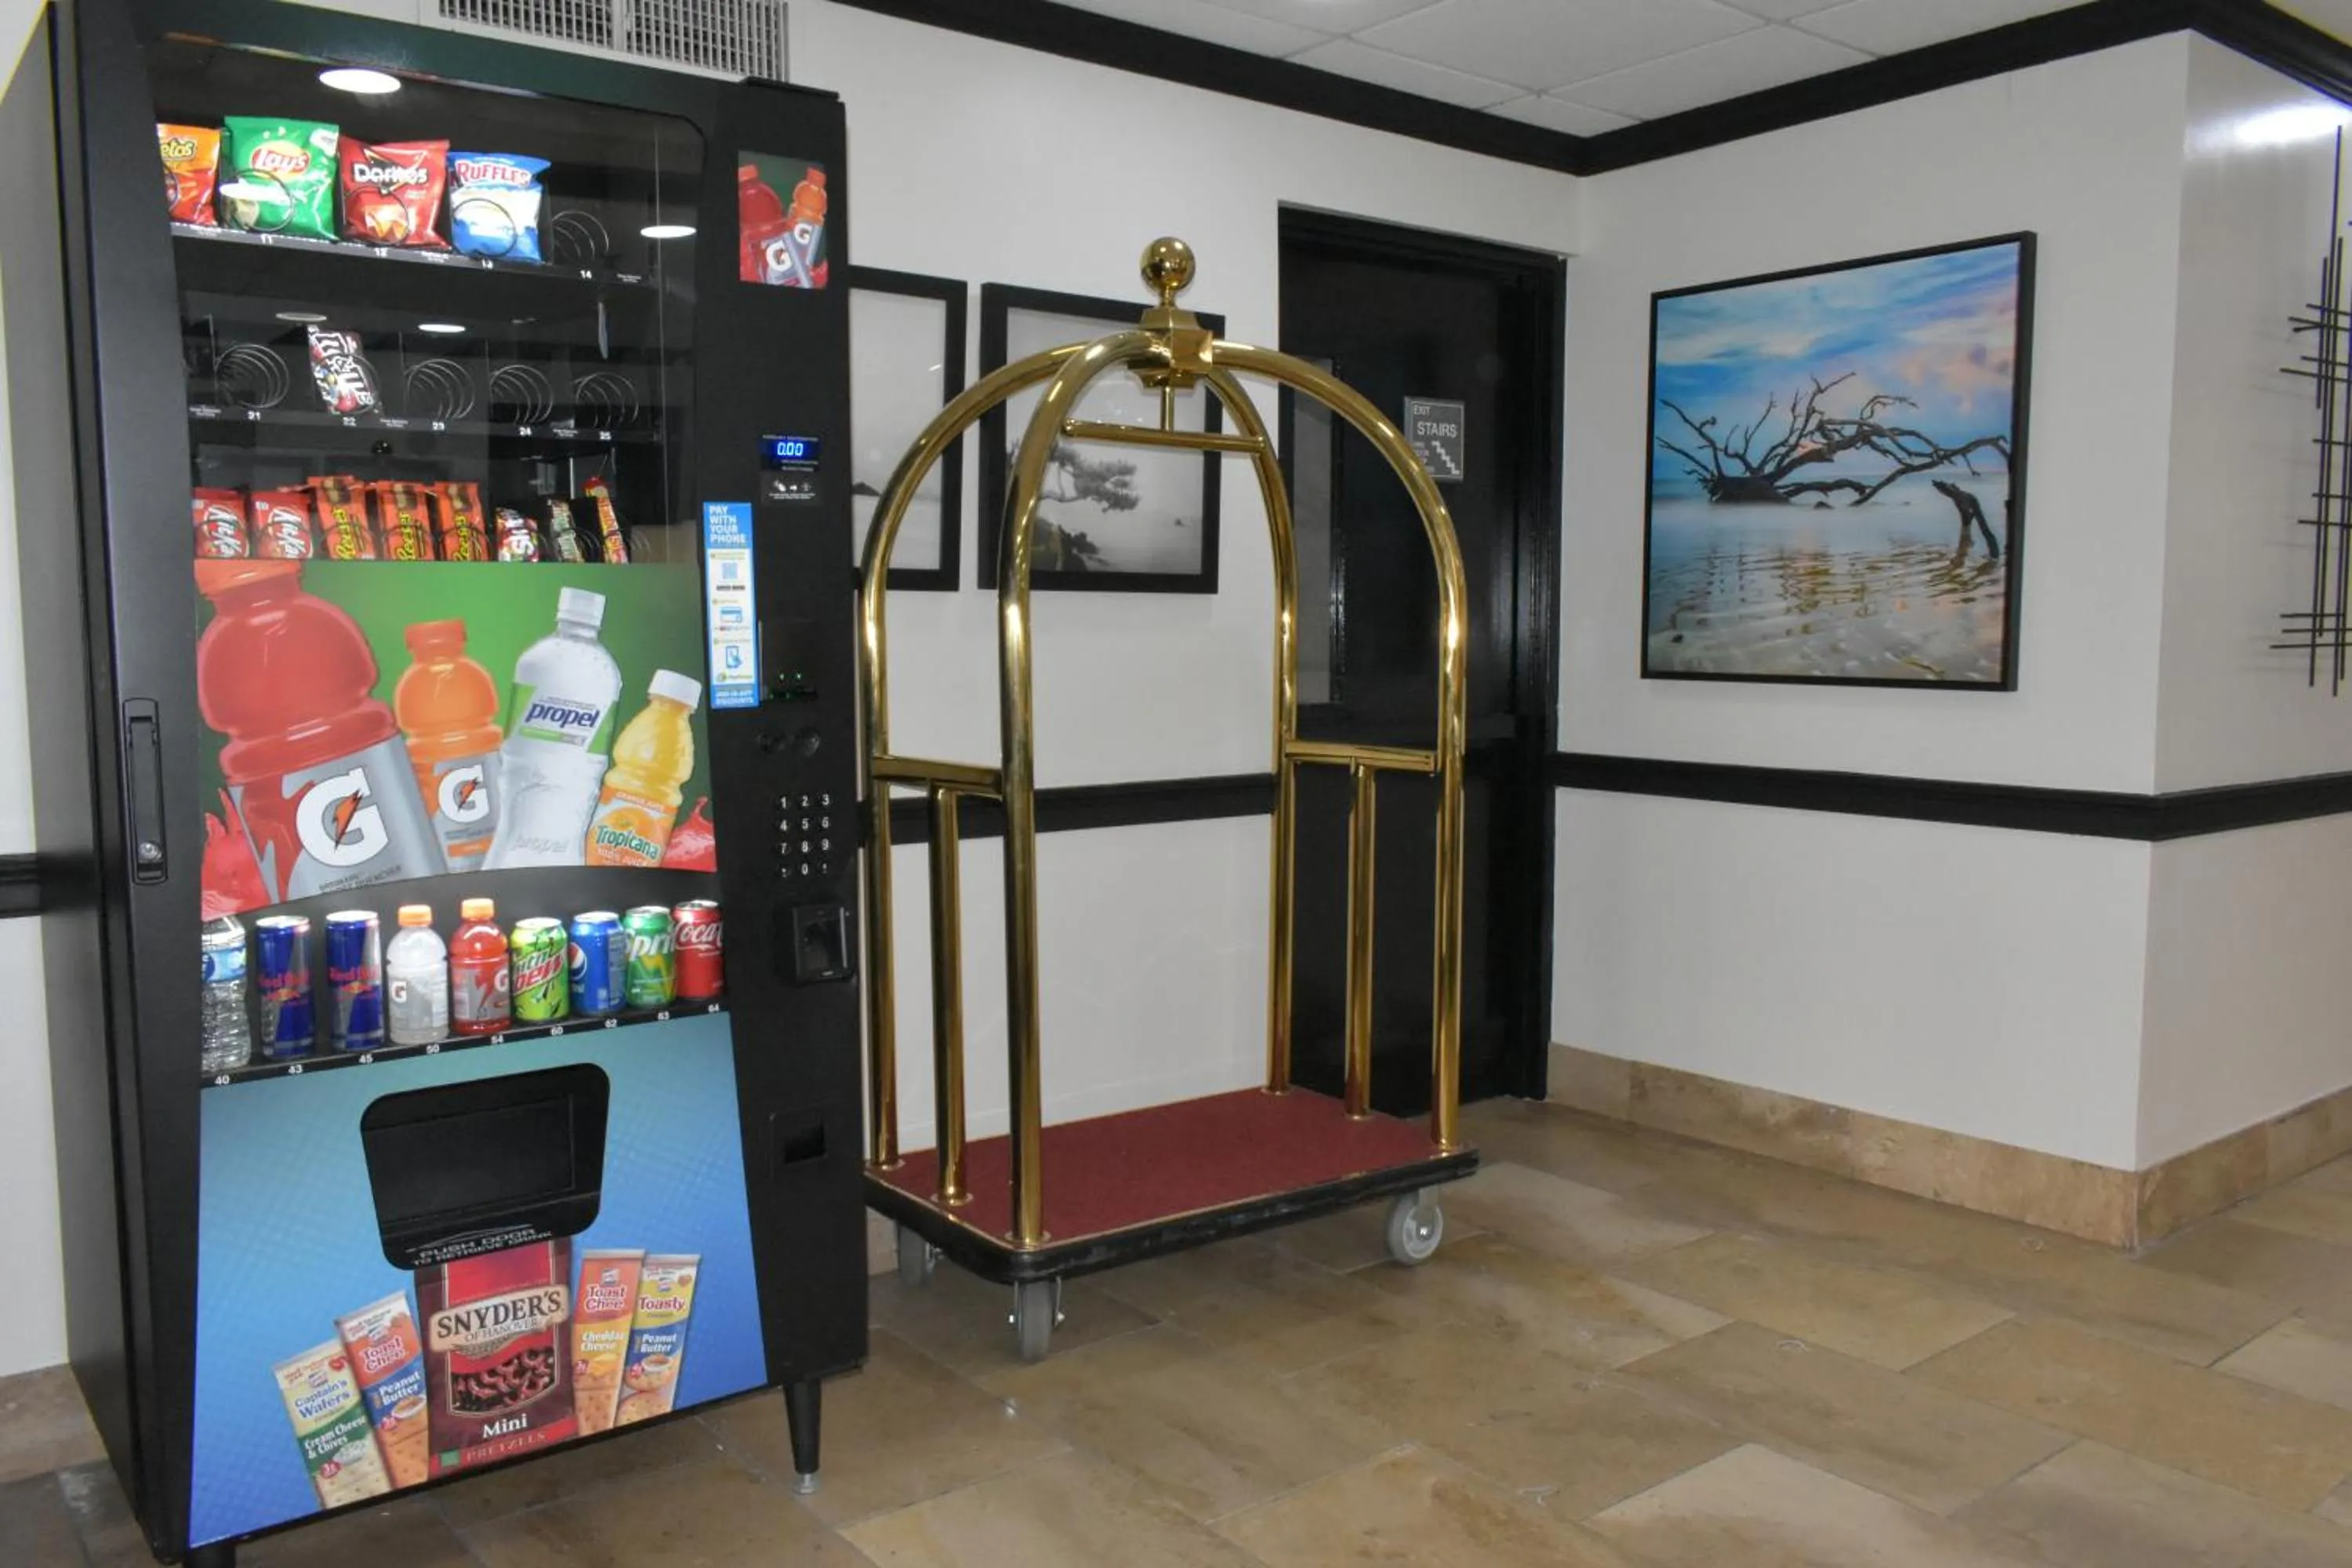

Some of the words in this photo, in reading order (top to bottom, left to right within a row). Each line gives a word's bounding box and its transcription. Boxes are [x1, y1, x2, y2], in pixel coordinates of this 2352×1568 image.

[766, 240, 792, 271] G
[1414, 405, 1430, 416] EXIT
[1417, 421, 1457, 438] STAIRS
[524, 702, 600, 728] propel
[438, 764, 490, 822] G
[780, 796, 786, 809] 1
[802, 794, 810, 807] 2
[822, 793, 829, 805] 3
[296, 768, 389, 867] G
[779, 819, 788, 831] 4
[802, 818, 809, 830] 5
[821, 816, 829, 829] 6
[596, 825, 660, 860] Tropicana
[781, 842, 787, 854] 7
[801, 840, 809, 853] 8
[821, 838, 829, 851] 9
[801, 863, 808, 876] 0
[215, 1075, 230, 1085] 40
[640, 1296, 684, 1312] Toasty
[437, 1290, 564, 1339] SNYDER'S
[641, 1343, 672, 1352] Butter
[642, 1333, 677, 1344] Peanut
[379, 1370, 420, 1396] Peanut
[294, 1379, 348, 1408] Captain's
[382, 1383, 419, 1406] Butter
[299, 1391, 351, 1418] Wafers
[483, 1413, 528, 1439] Mini
[304, 1431, 335, 1450] Cream
[318, 1436, 348, 1454] Chives
